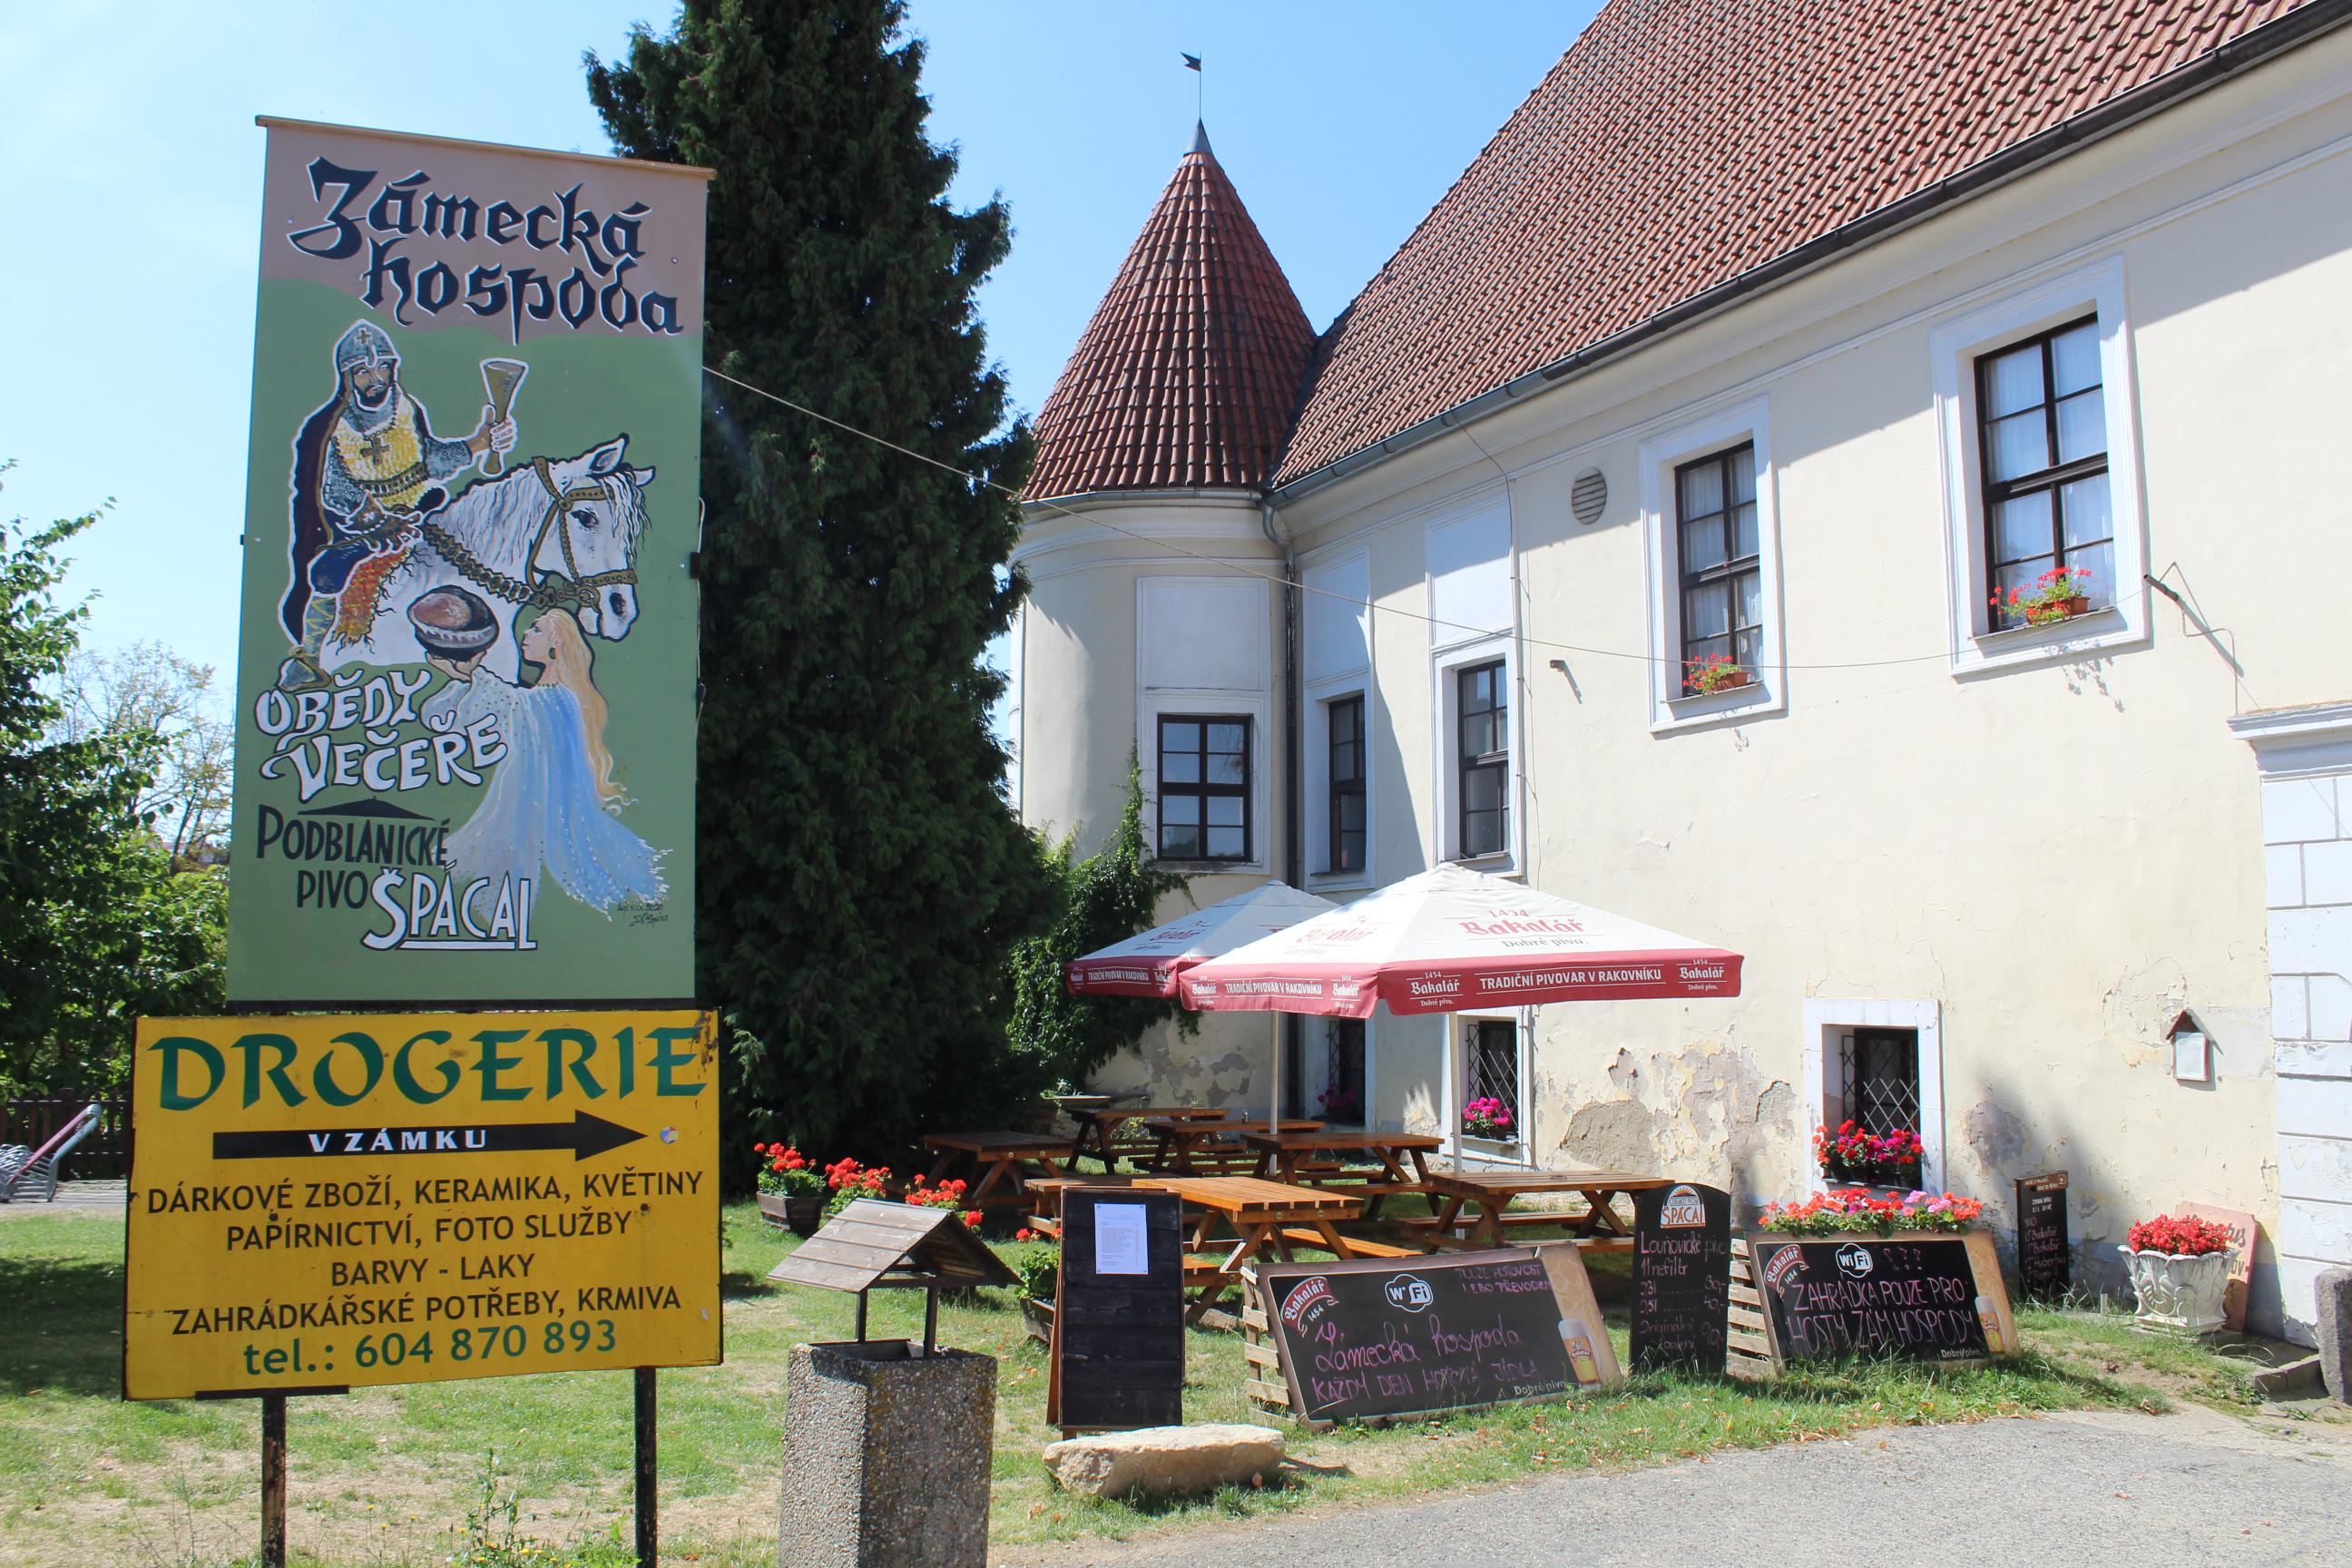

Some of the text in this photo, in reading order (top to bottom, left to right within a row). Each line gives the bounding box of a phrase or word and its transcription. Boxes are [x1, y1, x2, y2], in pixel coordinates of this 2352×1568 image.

[286, 155, 652, 278] Zámecká
[359, 236, 685, 347] hospoda
[254, 669, 432, 742] OBĚDY
[260, 710, 508, 804] VEČEŘE
[258, 804, 451, 867] PODBLANICKÉ
[297, 869, 368, 908] PIVO
[360, 860, 538, 951] ŠPÁCAL
[1459, 919, 1585, 936] Bakalář
[1489, 908, 1530, 918] 1454
[1502, 938, 1549, 947] Dobré
[1225, 980, 1322, 995] TRADIČNÍ PIVOVAR V RAKOVNÍKU
[1332, 983, 1359, 996] Bakalář
[1410, 979, 1460, 995] Bakalář
[1425, 971, 1442, 979] 1454
[1480, 967, 1661, 990] TRADIČNÍ PIVOVAR V RAKOVNÍKU
[1679, 965, 1724, 980] Bakalář
[1420, 998, 1438, 1007] Dobré
[147, 1026, 708, 1111] DROGERIE
[309, 1128, 487, 1153] V ZÁMKU
[147, 1166, 703, 1215] DÁRKOVÉ ZBOŽÍ, KERAMIKA, KVĚTINY
[227, 1206, 632, 1250] PAPÍRNICTVÍ, FOTO SLUŽBY
[331, 1258, 428, 1288] BARVY
[460, 1253, 535, 1281] LAKY
[1765, 1248, 1799, 1284] Bakalář
[1784, 1269, 1798, 1285] 1454
[1284, 1279, 1326, 1320] Bakalář
[1791, 1272, 1965, 1311] ZAHRÁDKA POUZE PRO
[172, 1285, 681, 1336] ZAHRÁDKÁŘSKÉ POTŘEBY, KRMIVA
[1307, 1304, 1325, 1322] 1454
[243, 1318, 616, 1376] tel.: 604 870 893
[1430, 1314, 1524, 1361] hospoda
[1786, 1313, 1853, 1354] HOSTY
[1377, 1373, 1414, 1396] DEN
